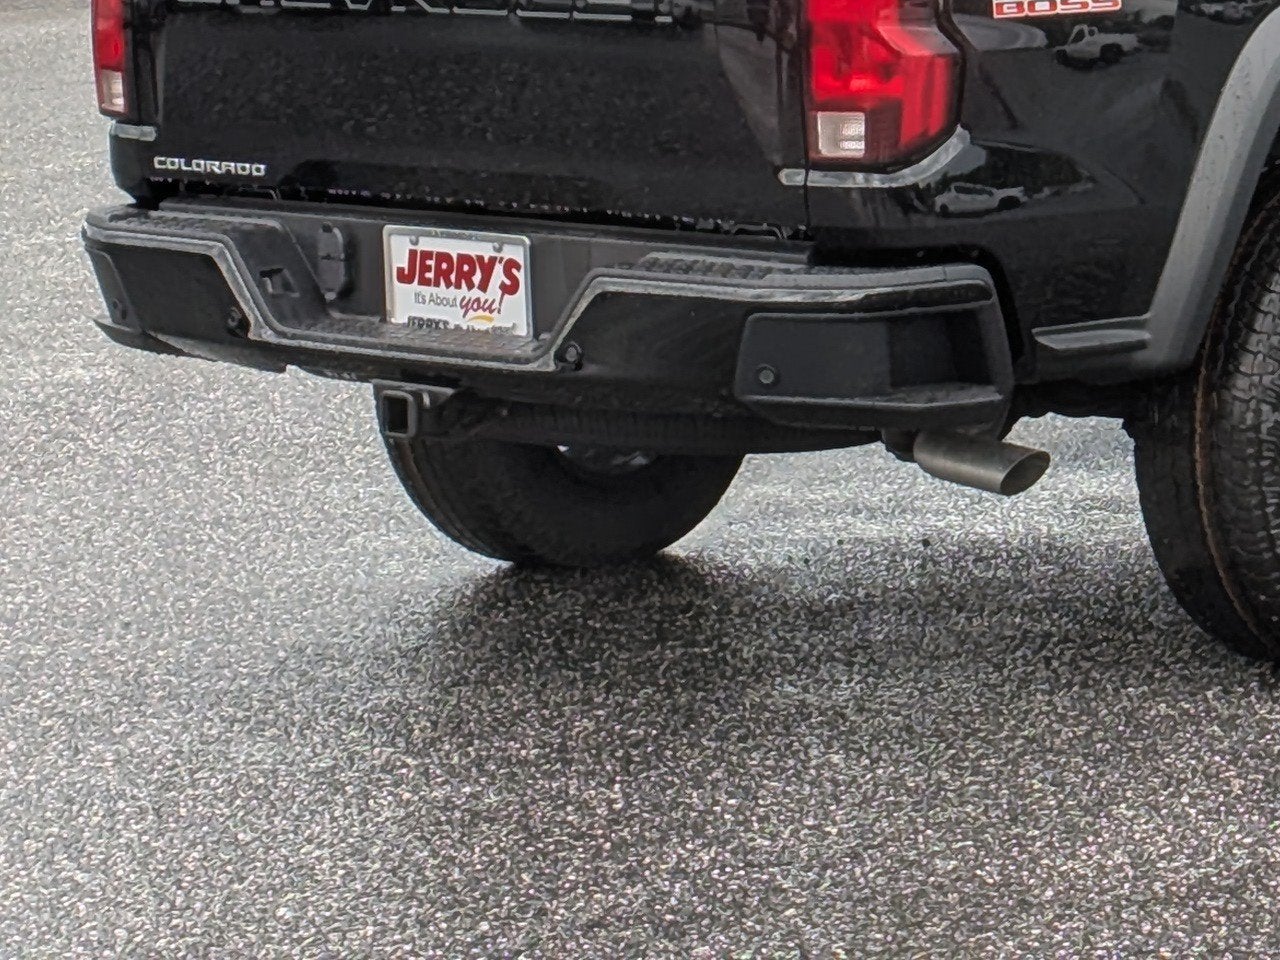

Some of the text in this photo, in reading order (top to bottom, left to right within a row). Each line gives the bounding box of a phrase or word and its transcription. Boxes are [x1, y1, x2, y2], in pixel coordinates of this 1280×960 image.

[153, 156, 266, 176] COLORADO
[396, 248, 522, 296] JERRY'S
[414, 292, 427, 305] It's
[428, 294, 458, 308] About
